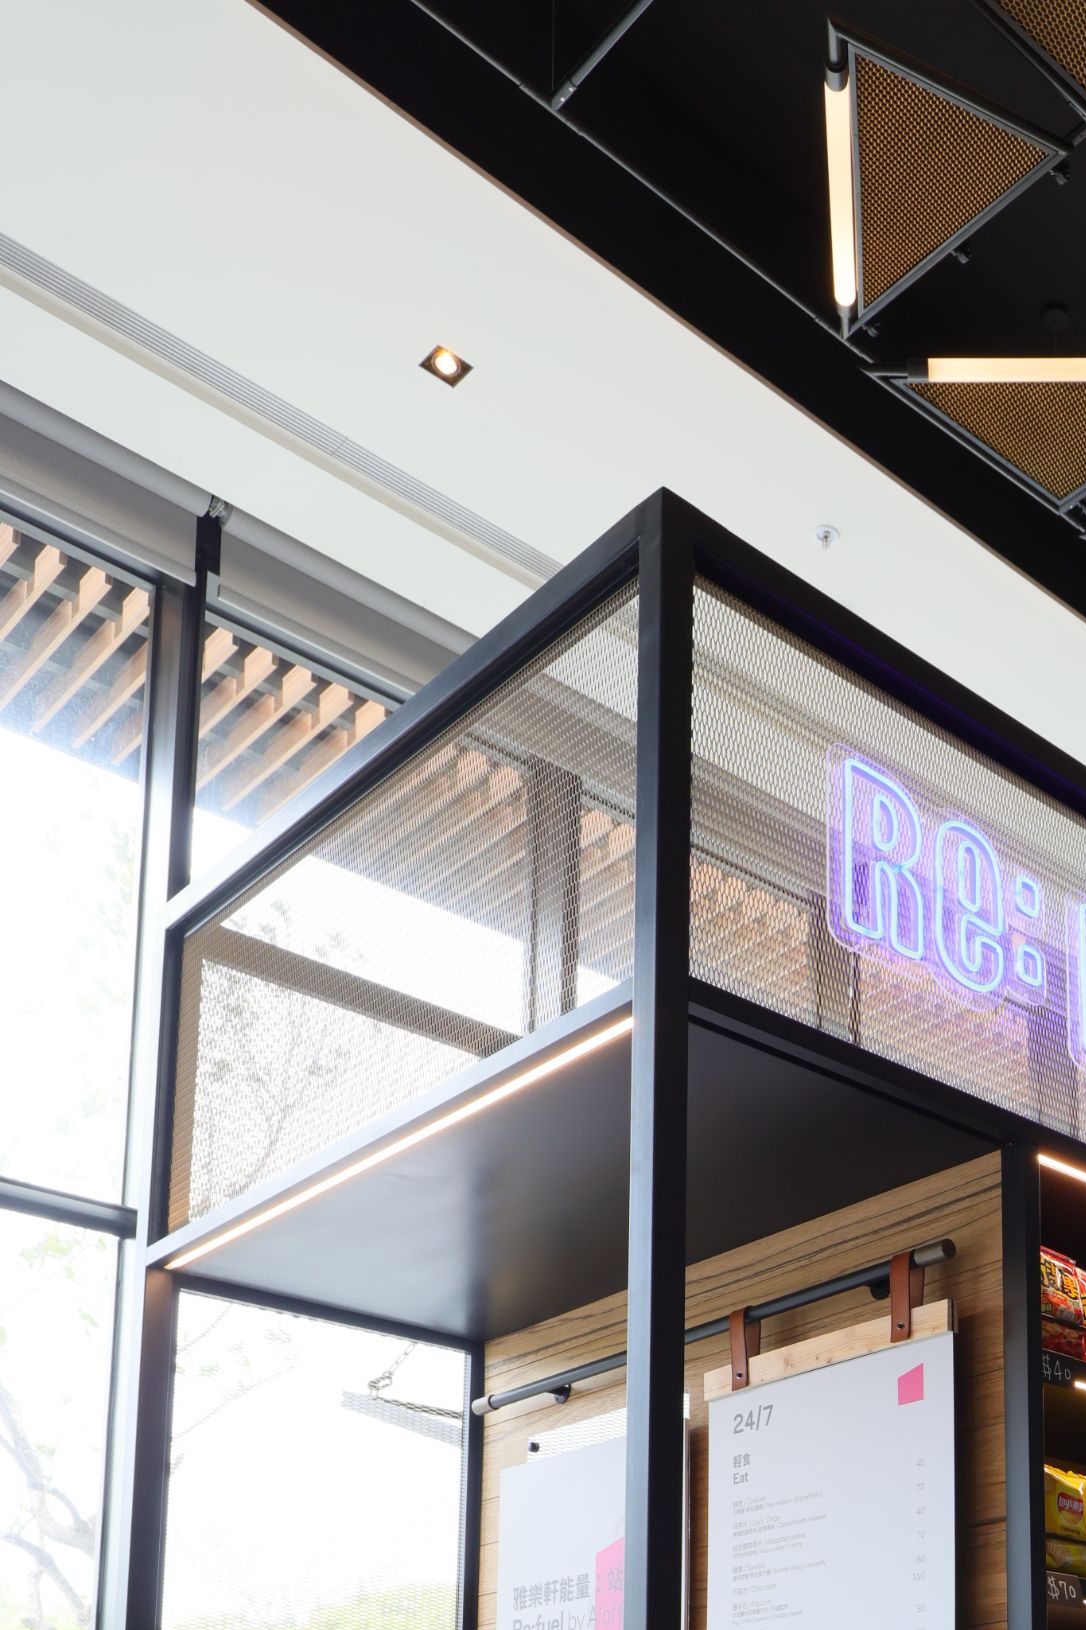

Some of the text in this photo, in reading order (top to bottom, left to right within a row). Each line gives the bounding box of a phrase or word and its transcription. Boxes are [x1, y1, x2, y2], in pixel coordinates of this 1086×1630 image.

[843, 758, 1045, 993] Re:
[1042, 1354, 1072, 1382] $40
[733, 1404, 774, 1435] 24/7
[733, 1472, 749, 1485] Eat
[1048, 1577, 1077, 1600] $70
